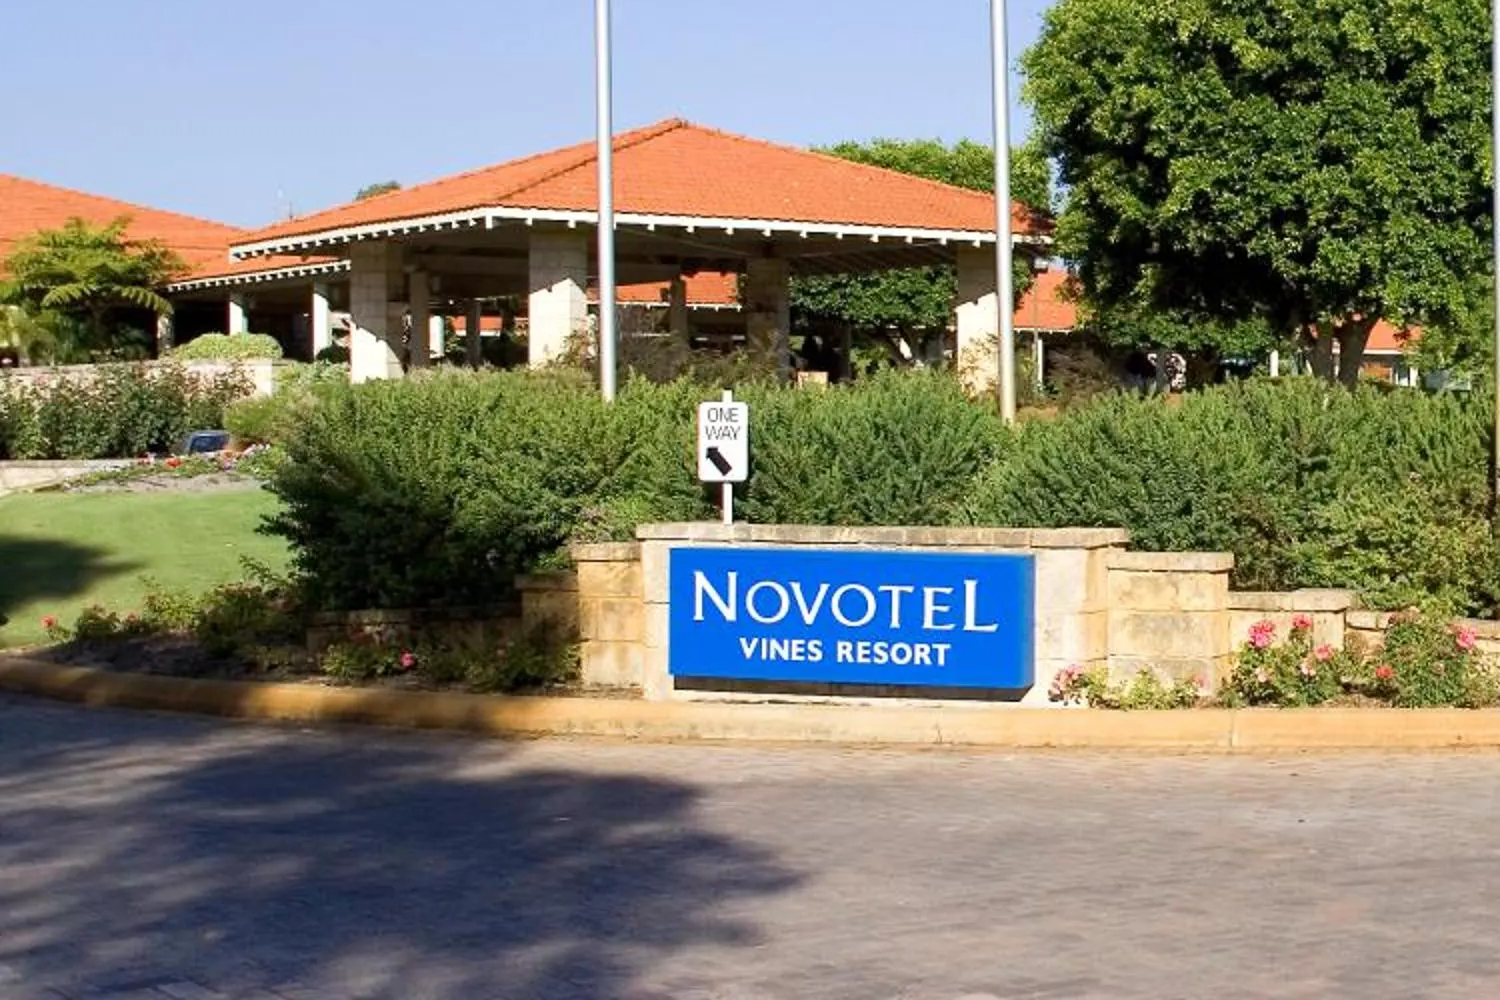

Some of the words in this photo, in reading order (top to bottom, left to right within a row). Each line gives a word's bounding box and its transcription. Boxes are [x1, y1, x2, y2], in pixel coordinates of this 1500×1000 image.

[707, 408, 739, 423] ONE
[704, 425, 741, 441] WAY
[692, 570, 999, 633] NOVOTEL
[739, 637, 823, 662] VINES
[837, 640, 951, 667] RESORT
